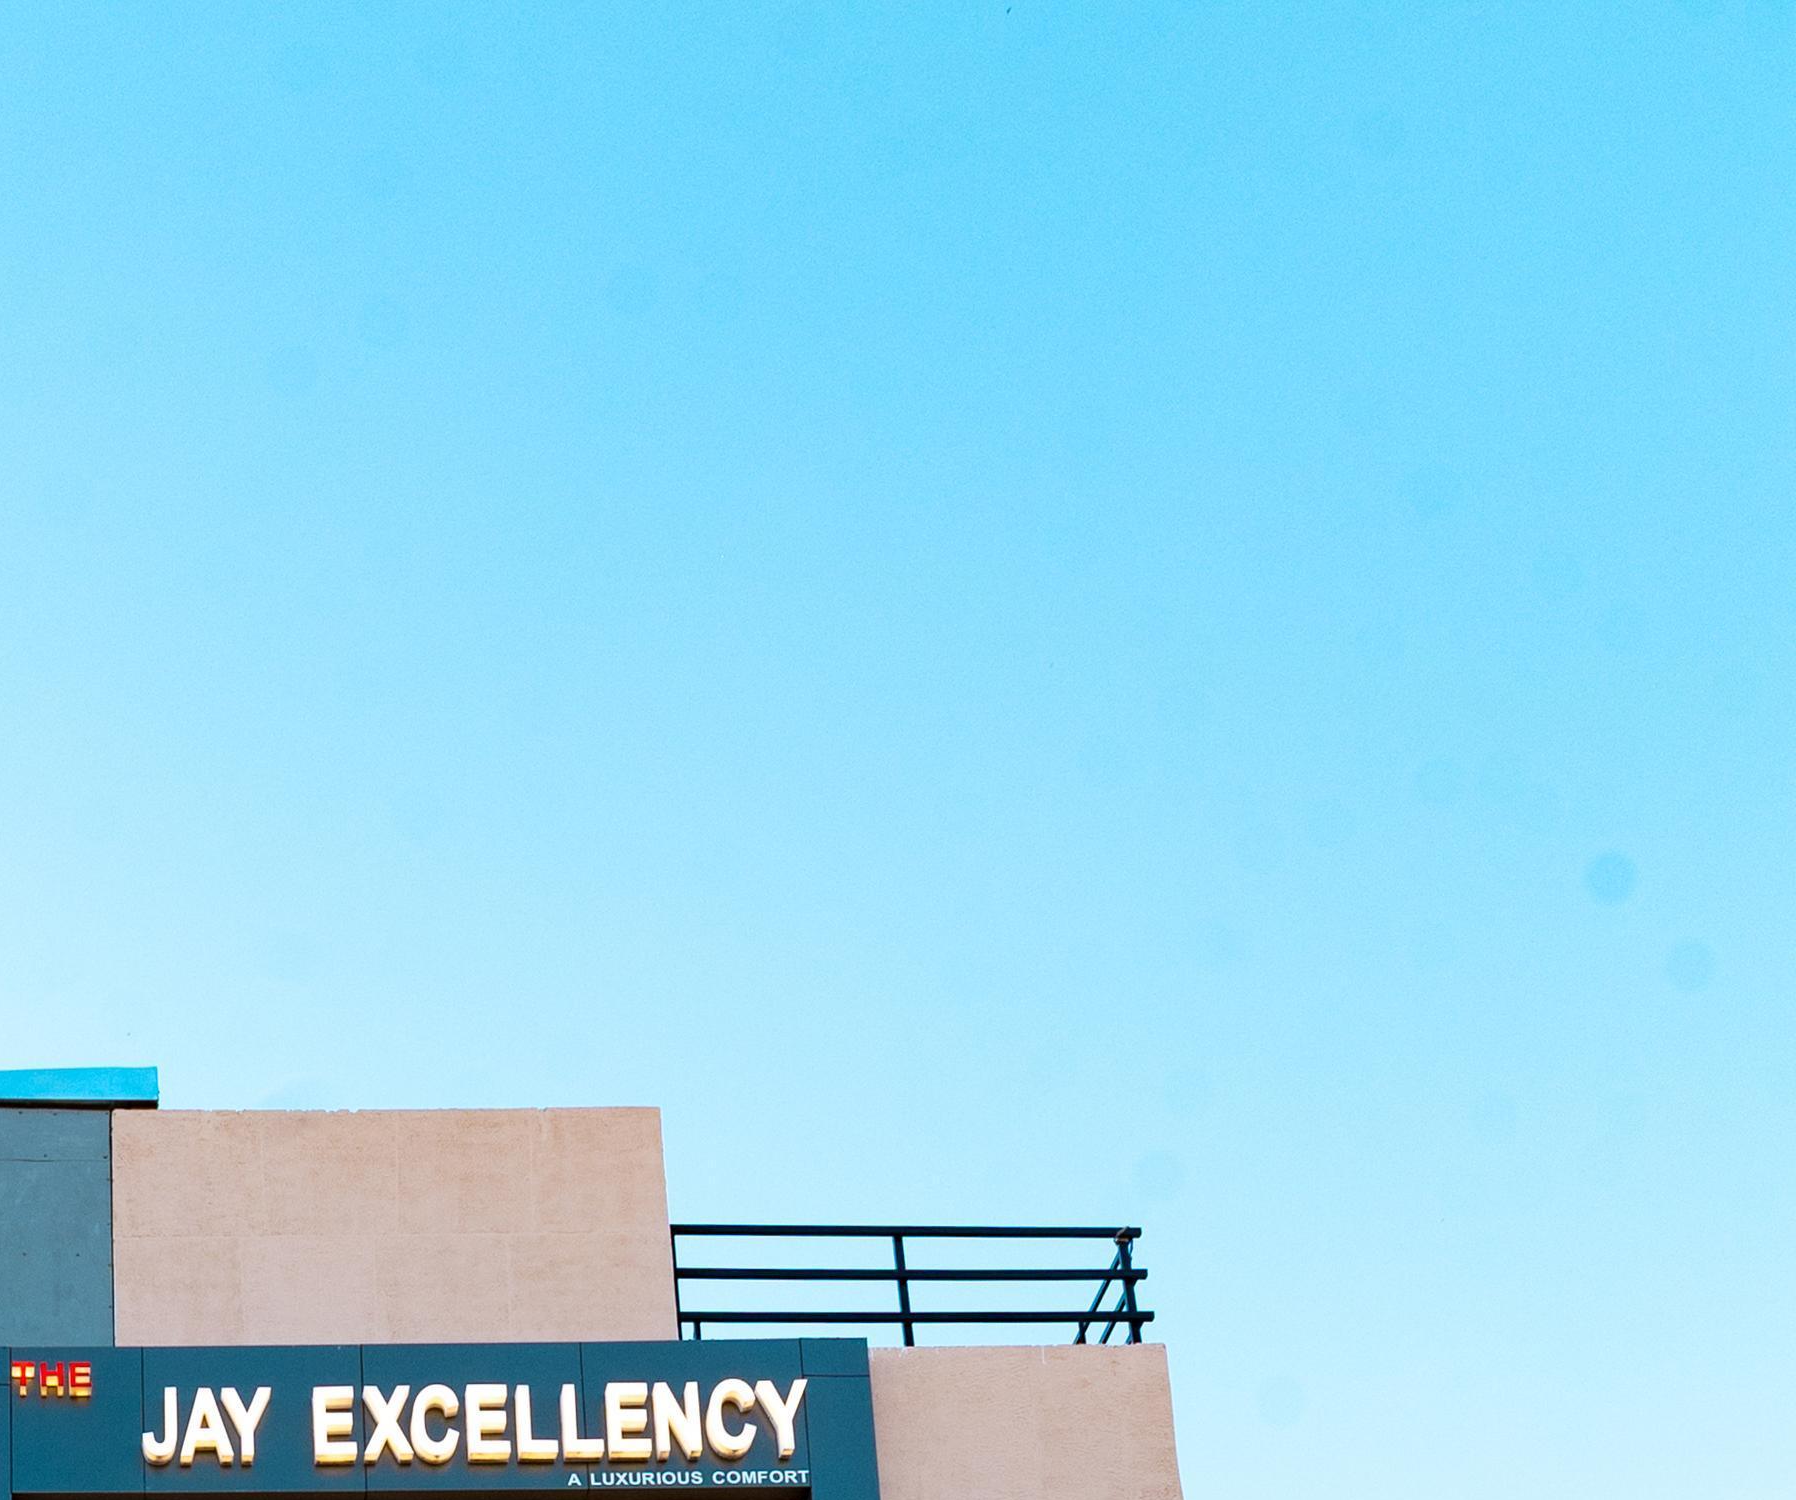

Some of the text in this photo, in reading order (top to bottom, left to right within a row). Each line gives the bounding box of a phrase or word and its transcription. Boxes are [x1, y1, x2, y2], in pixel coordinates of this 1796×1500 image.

[11, 1360, 93, 1398] THE
[142, 1378, 808, 1467] JAY EXCELLENCY
[567, 1468, 810, 1486] A LUXURIOUS COMFORT
